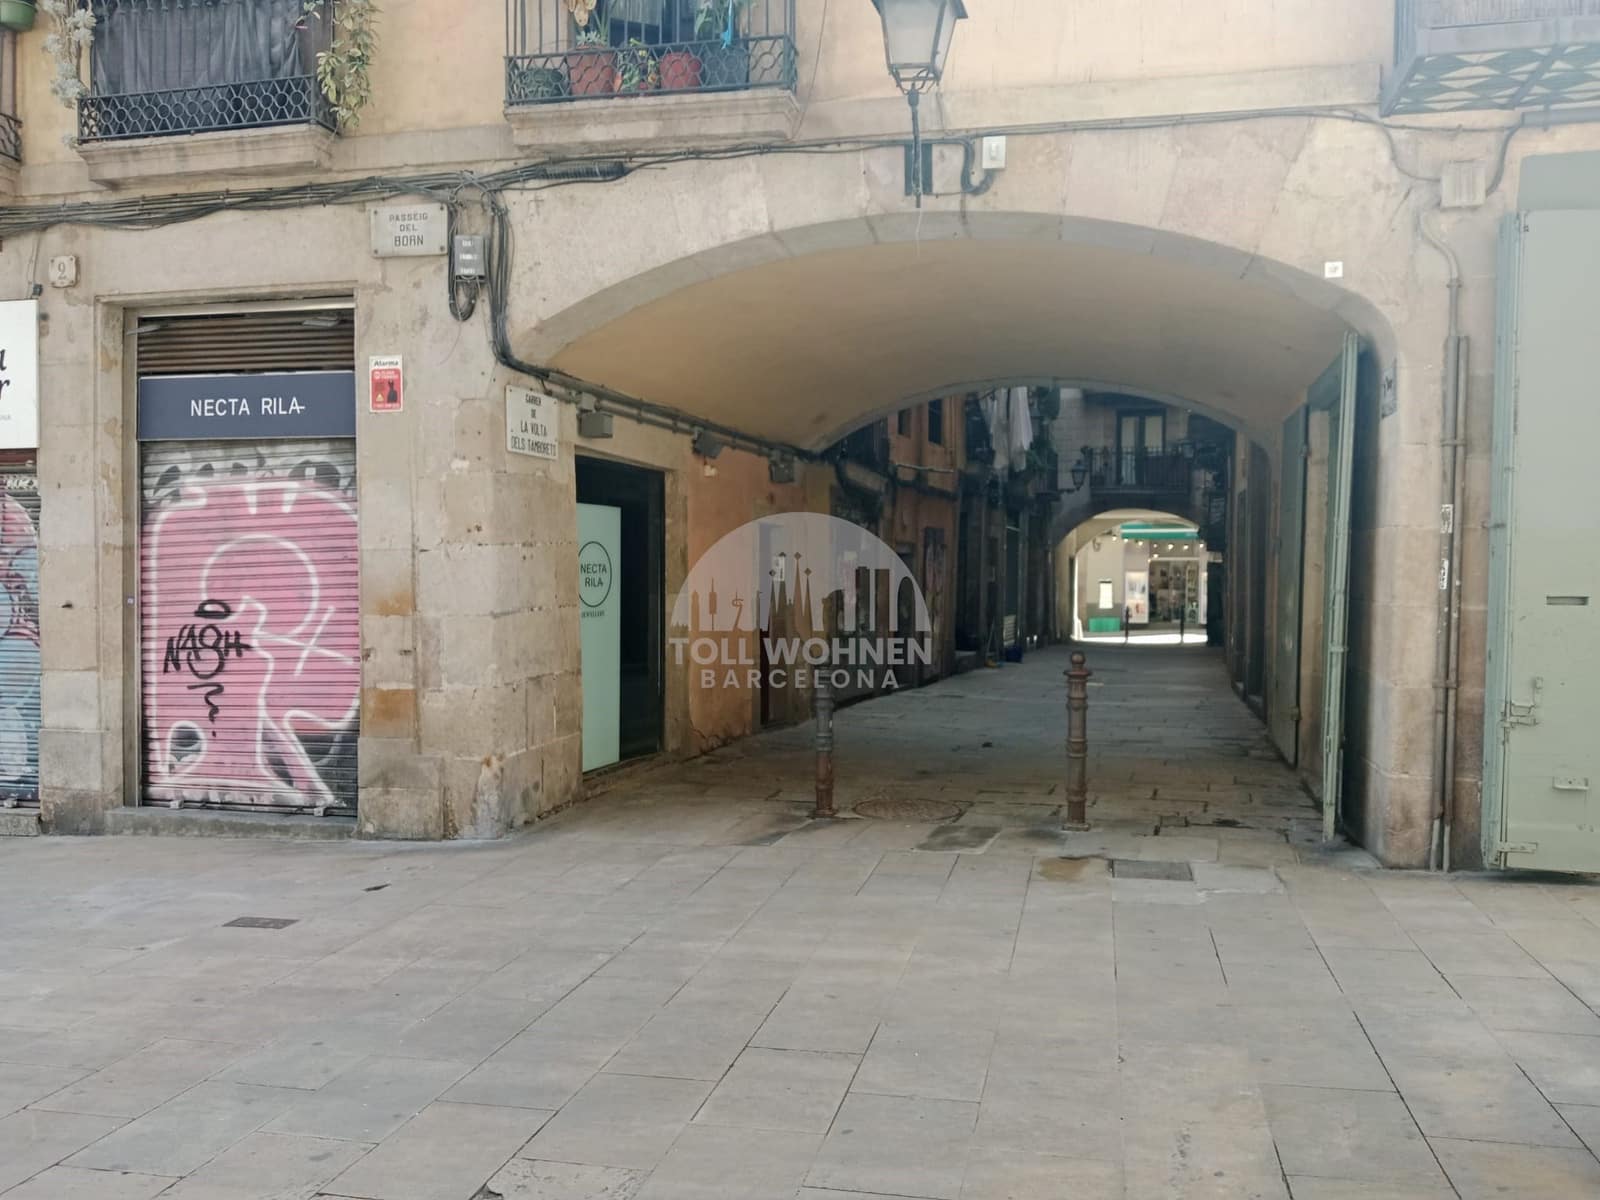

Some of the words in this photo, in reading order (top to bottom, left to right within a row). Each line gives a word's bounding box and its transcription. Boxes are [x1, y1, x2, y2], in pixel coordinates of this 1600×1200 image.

[389, 212, 428, 222] PASSEIG
[399, 224, 418, 232] DEL
[394, 235, 424, 247] BORN
[525, 393, 542, 407] CARRER
[190, 397, 250, 417] NECTA
[530, 408, 537, 419] DE
[520, 420, 529, 434] LA
[530, 422, 547, 437] VOLTA
[511, 435, 526, 451] DELS
[580, 563, 607, 575] NECTA
